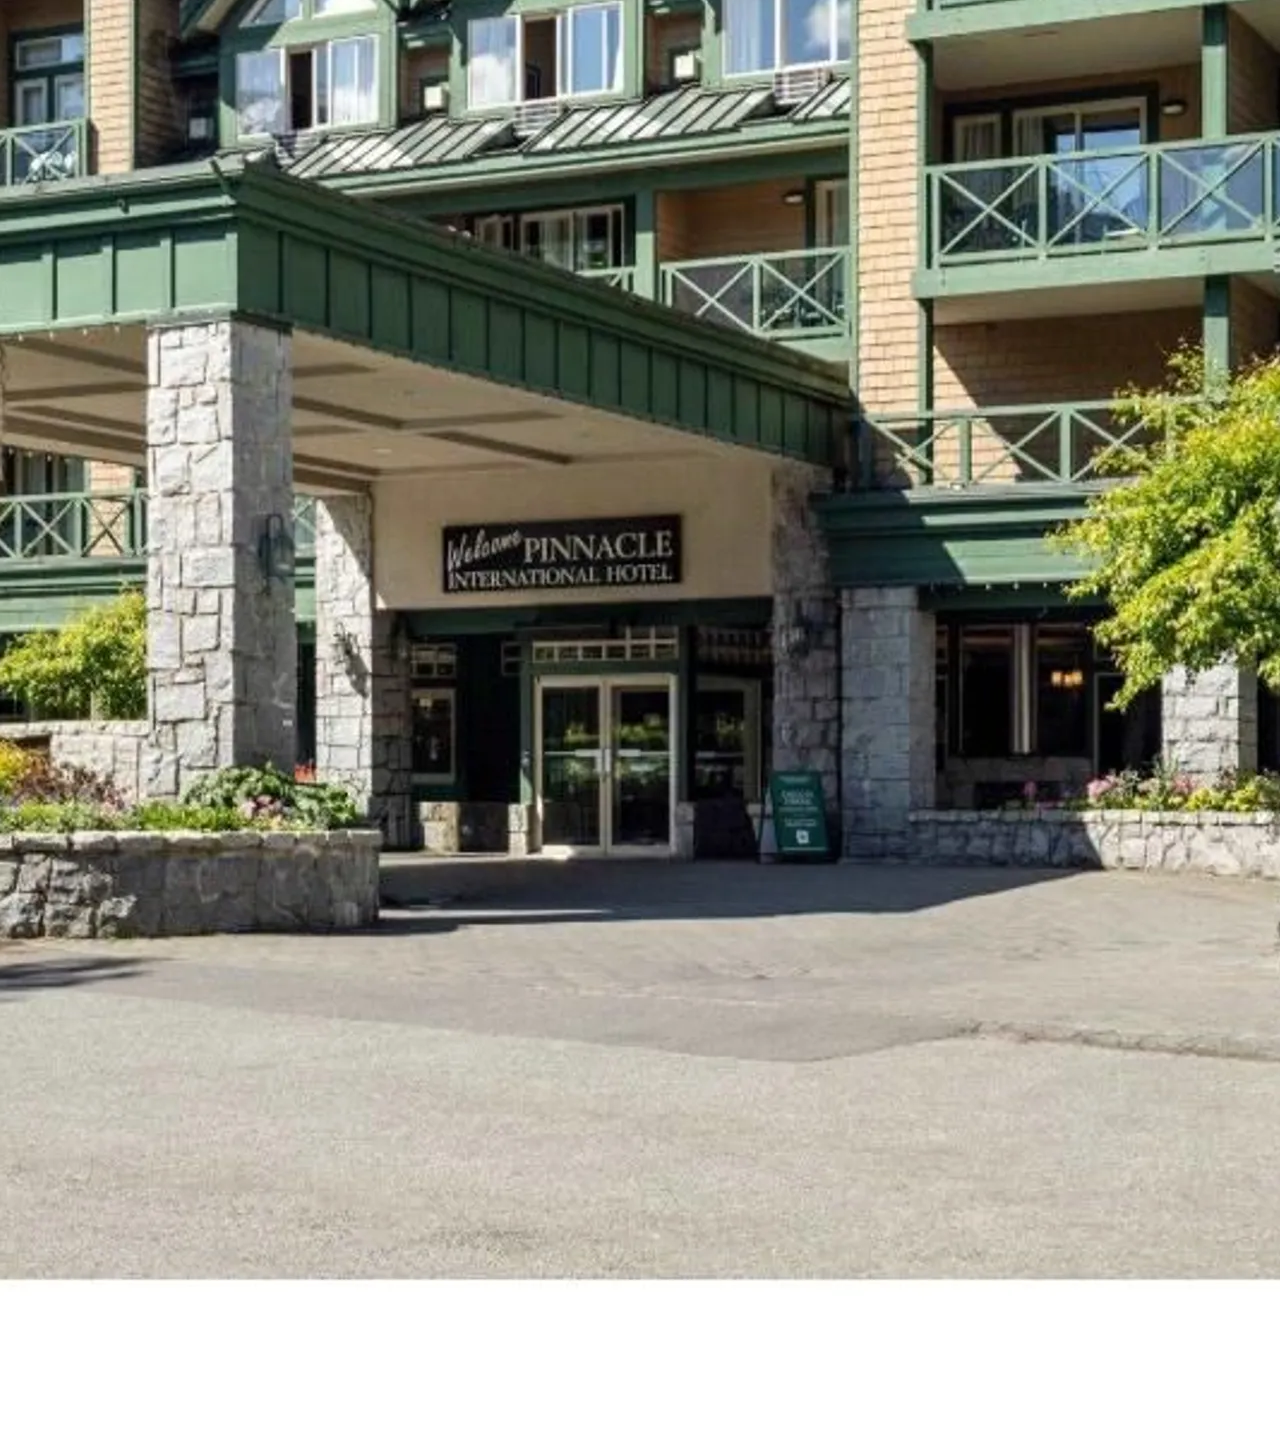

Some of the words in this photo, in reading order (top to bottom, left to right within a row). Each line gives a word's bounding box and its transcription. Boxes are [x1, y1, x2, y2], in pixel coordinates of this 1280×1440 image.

[447, 528, 521, 572] Welcome
[524, 530, 674, 564] PINNACLE
[447, 566, 601, 590] INTERNATIONAL
[606, 562, 674, 583] HOTEL
